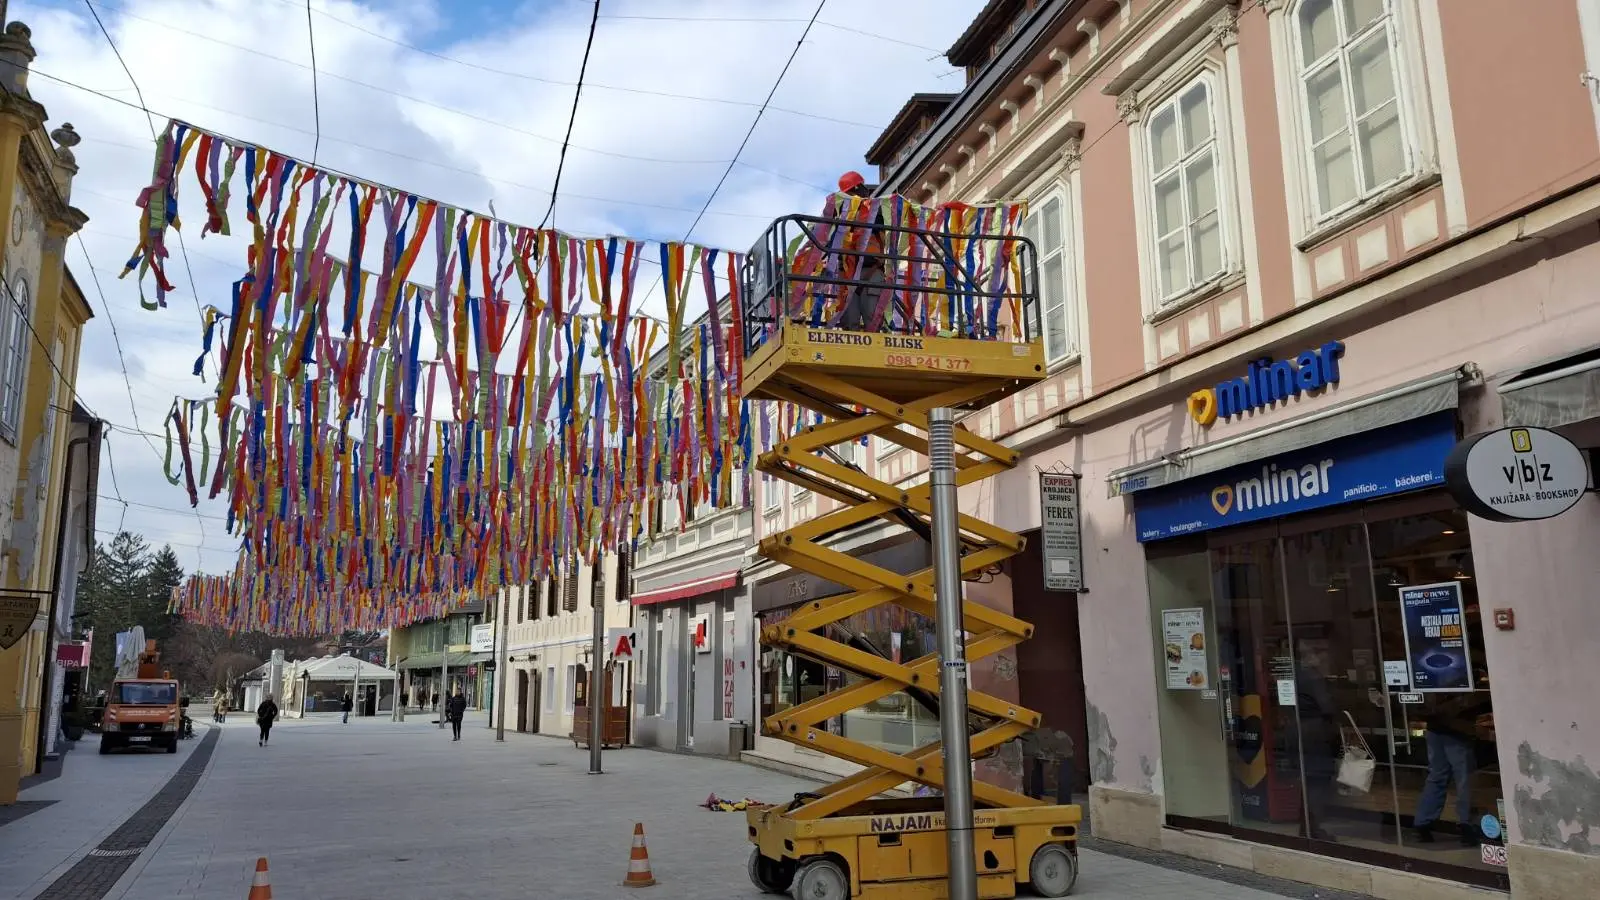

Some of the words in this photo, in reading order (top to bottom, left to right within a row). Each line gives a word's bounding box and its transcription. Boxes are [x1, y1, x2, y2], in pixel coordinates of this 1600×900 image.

[808, 331, 872, 346] ELEKTRO
[884, 336, 923, 349] BLISK
[887, 354, 911, 366] 098
[946, 358, 970, 370] 377
[1216, 340, 1344, 418] mlinar
[1044, 477, 1073, 487] EXPRES
[1120, 476, 1148, 492] mlinar
[1235, 458, 1334, 511] mlinar
[1048, 494, 1072, 502] SERVIS
[1490, 491, 1531, 505] KNJIŽARA
[1536, 488, 1579, 501] BOOKSHOP
[1170, 520, 1202, 533] boulangerie
[1343, 482, 1378, 499] panificio
[614, 632, 636, 656] A1
[871, 815, 932, 832] NAJAM
